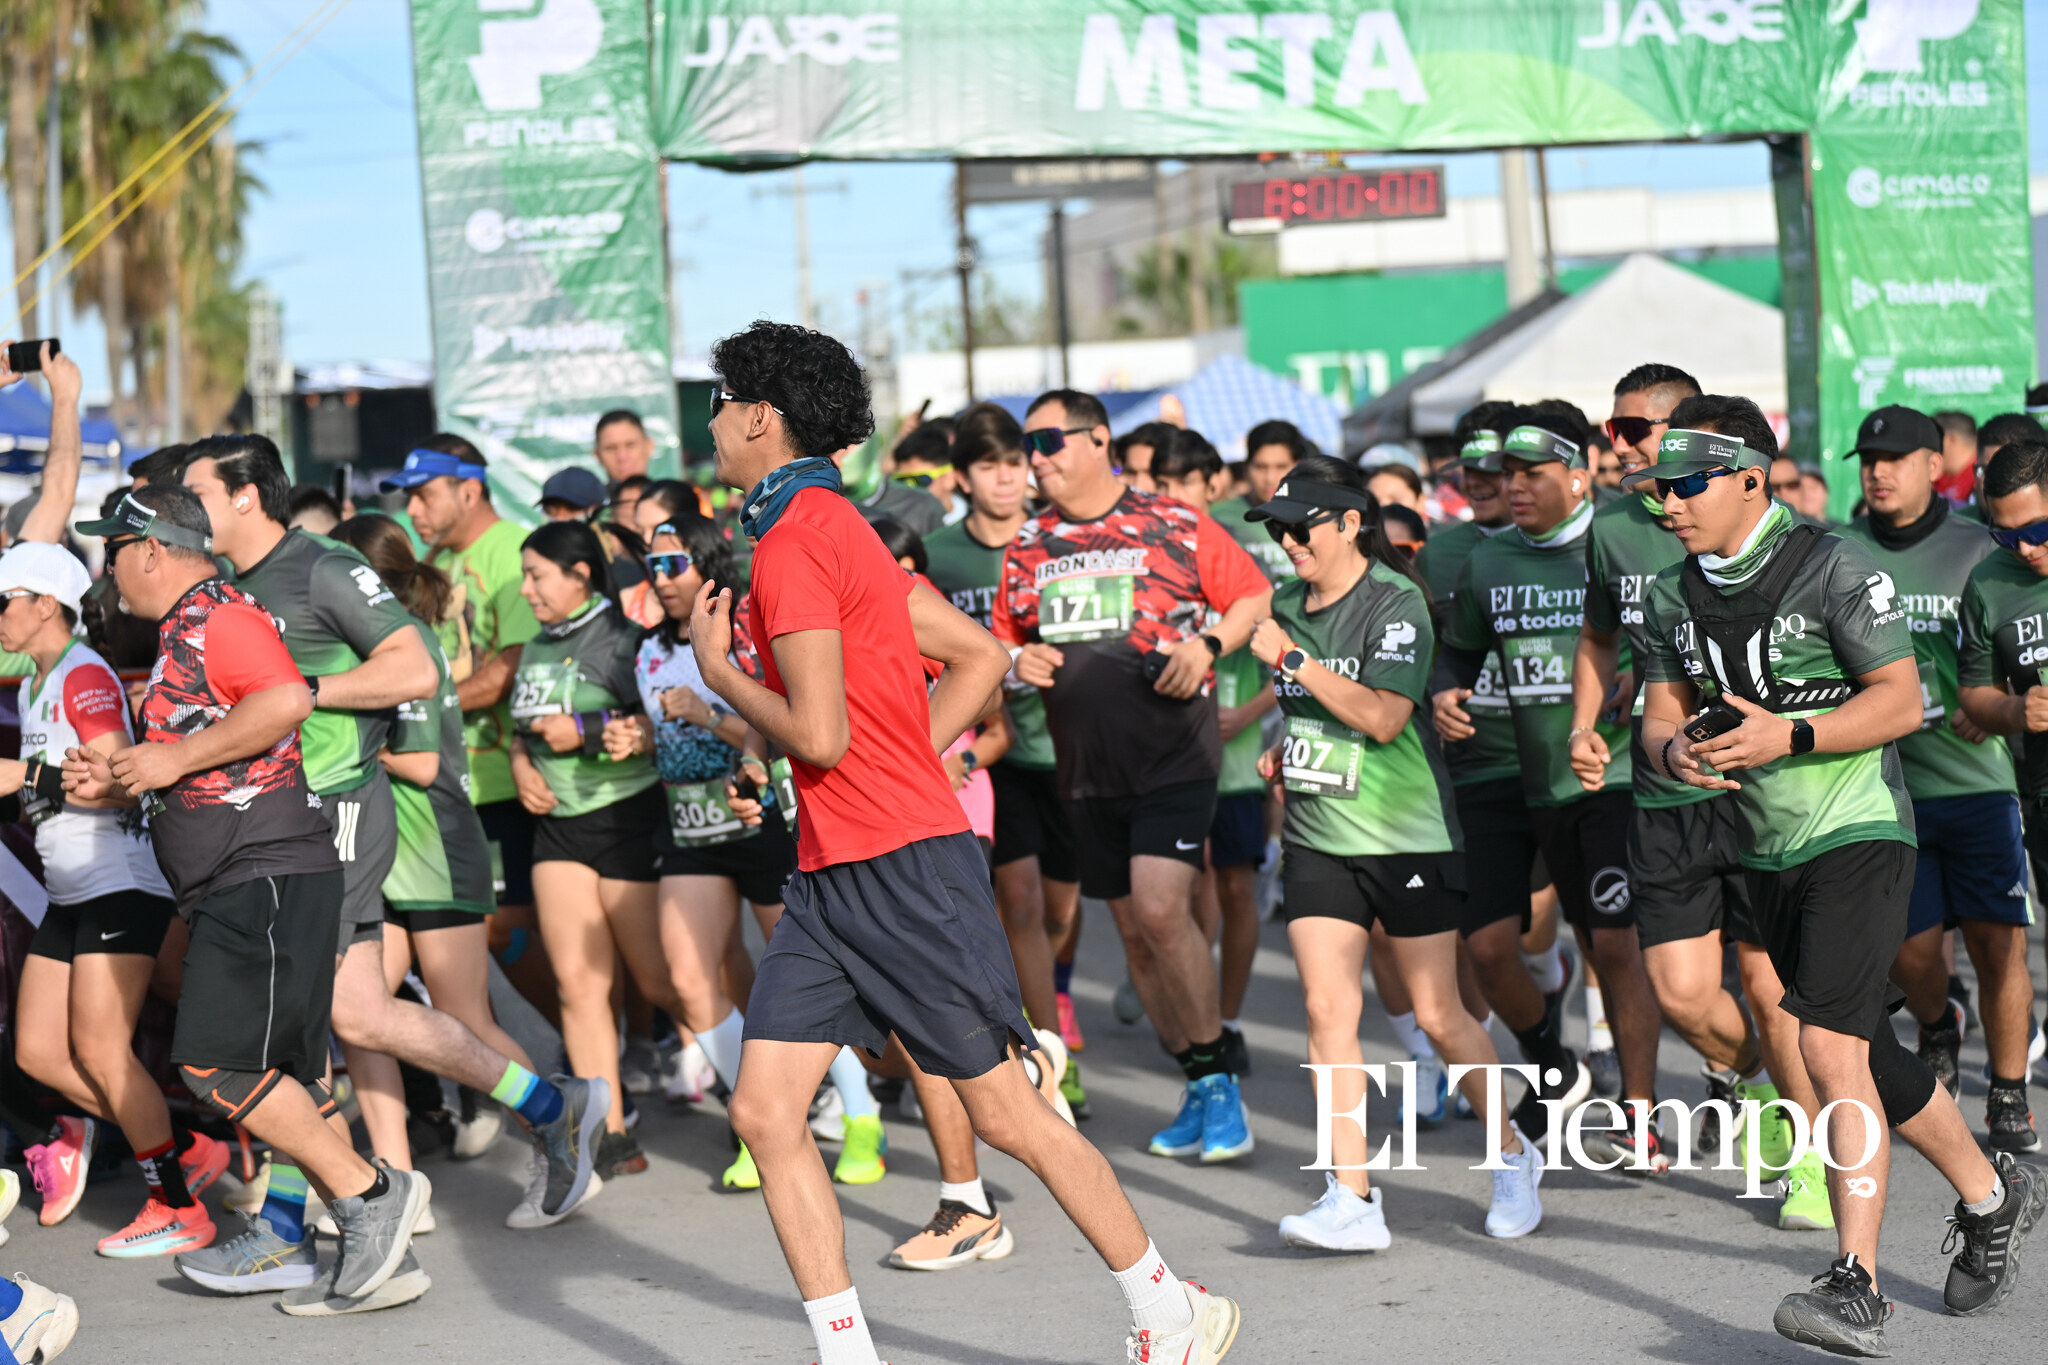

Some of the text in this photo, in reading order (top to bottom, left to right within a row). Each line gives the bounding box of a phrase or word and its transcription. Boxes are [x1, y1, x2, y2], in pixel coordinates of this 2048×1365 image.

[1075, 10, 1431, 110] META
[1490, 585, 1513, 613] El
[1620, 575, 1642, 602] El
[1050, 593, 1102, 624] 171
[1494, 611, 1584, 633] de todos
[1620, 606, 1644, 624] de
[1674, 621, 1697, 654] El
[2012, 613, 2044, 646] El
[1512, 656, 1566, 685] 134
[2018, 646, 2048, 666] de
[515, 680, 556, 708] 257
[1282, 735, 1334, 771] 207
[1345, 743, 1360, 792] MEDALLA
[674, 800, 726, 829] 306
[124, 1221, 177, 1243] BROOKS
